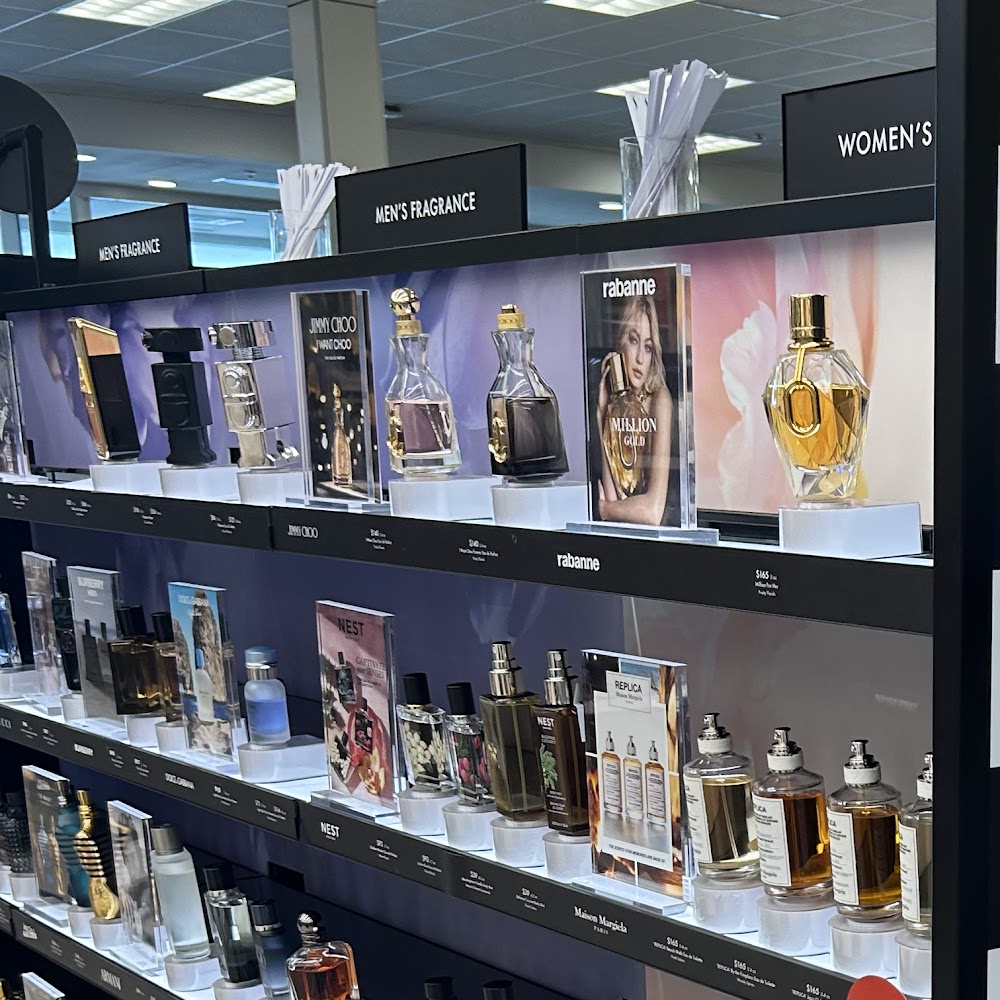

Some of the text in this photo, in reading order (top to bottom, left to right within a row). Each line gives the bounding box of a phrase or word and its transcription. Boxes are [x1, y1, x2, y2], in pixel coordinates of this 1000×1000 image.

[838, 121, 933, 158] WOMEN'S
[376, 191, 476, 225] MEN'S FRAGRANCE
[99, 238, 161, 261] MEN'S FRAGRANCE
[602, 276, 657, 299] rabanne
[309, 316, 357, 334] JIMMY CHOO
[333, 338, 352, 350] CHOO
[624, 434, 646, 447] GOLD
[557, 552, 600, 571] rabanne
[755, 569, 770, 580] $165
[338, 618, 364, 637] NEST
[615, 680, 643, 694] REPLICA
[537, 716, 554, 727] NEST
[320, 821, 340, 837] NEST
[574, 906, 628, 933] Maison Margiela
[666, 936, 679, 948] $165
[733, 959, 746, 971] $165
[806, 983, 819, 996] $165
